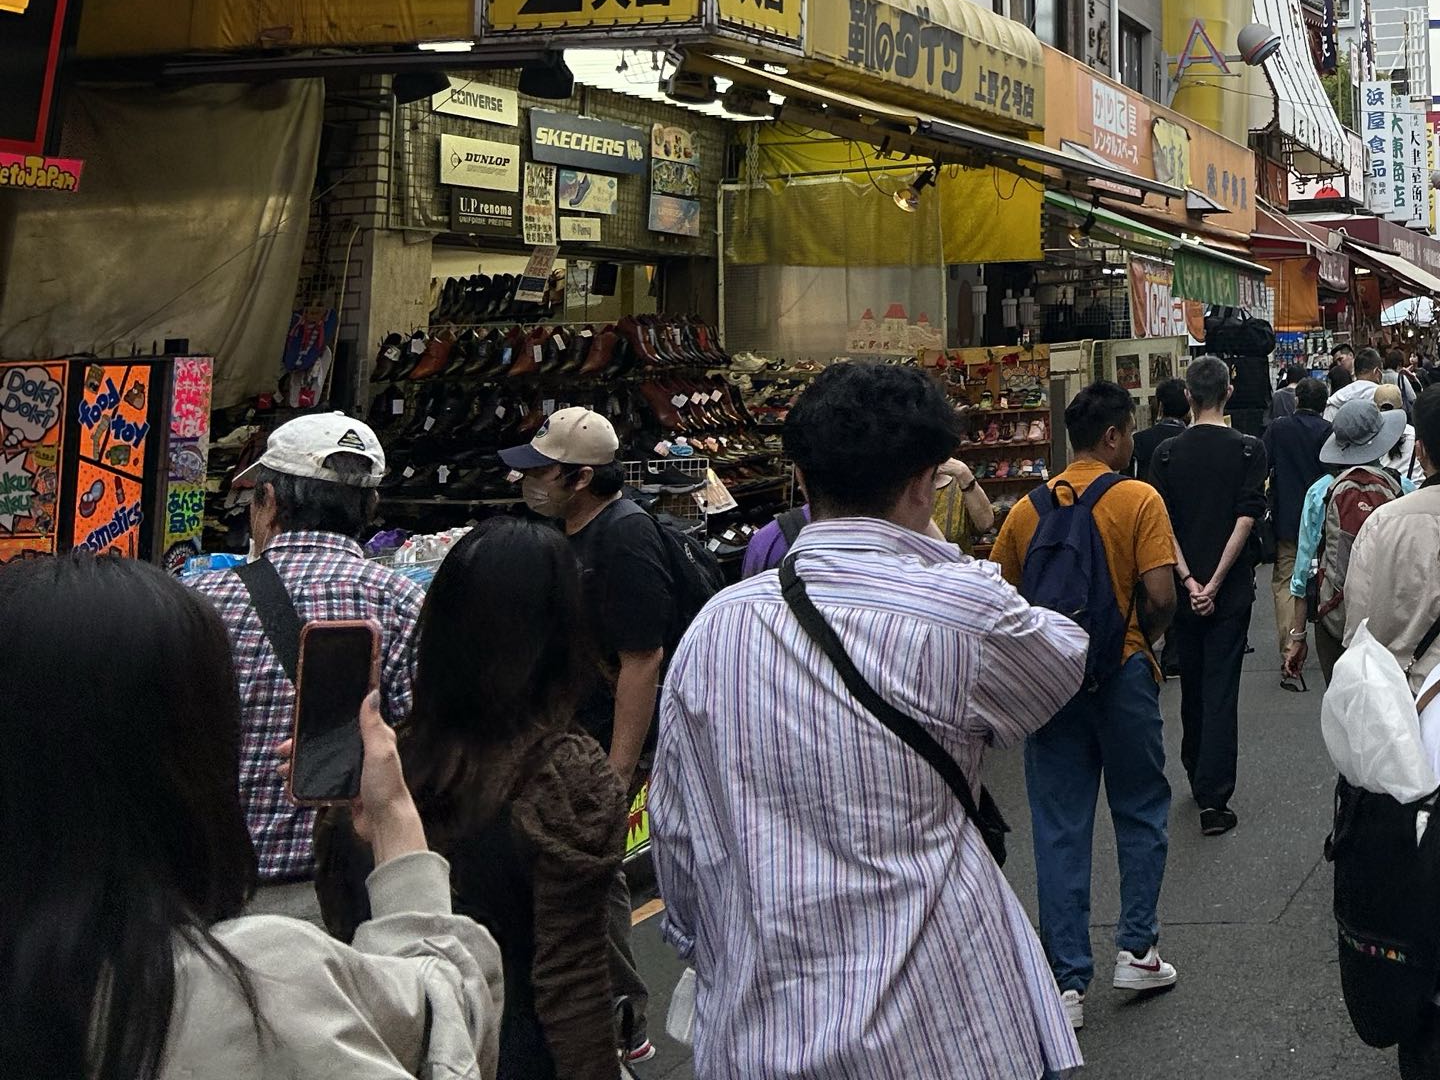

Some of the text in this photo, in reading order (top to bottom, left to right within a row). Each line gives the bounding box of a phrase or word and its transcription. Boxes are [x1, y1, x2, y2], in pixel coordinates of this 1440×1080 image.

[450, 88, 503, 113] CONVERSE
[974, 65, 1035, 122] 上野2号店
[535, 126, 626, 157] SKECHERS
[1366, 88, 1387, 178] 浜屋食品
[464, 152, 511, 167] DUNLOP
[480, 203, 513, 216] renoma
[78, 378, 121, 430] food
[110, 415, 151, 449] toy
